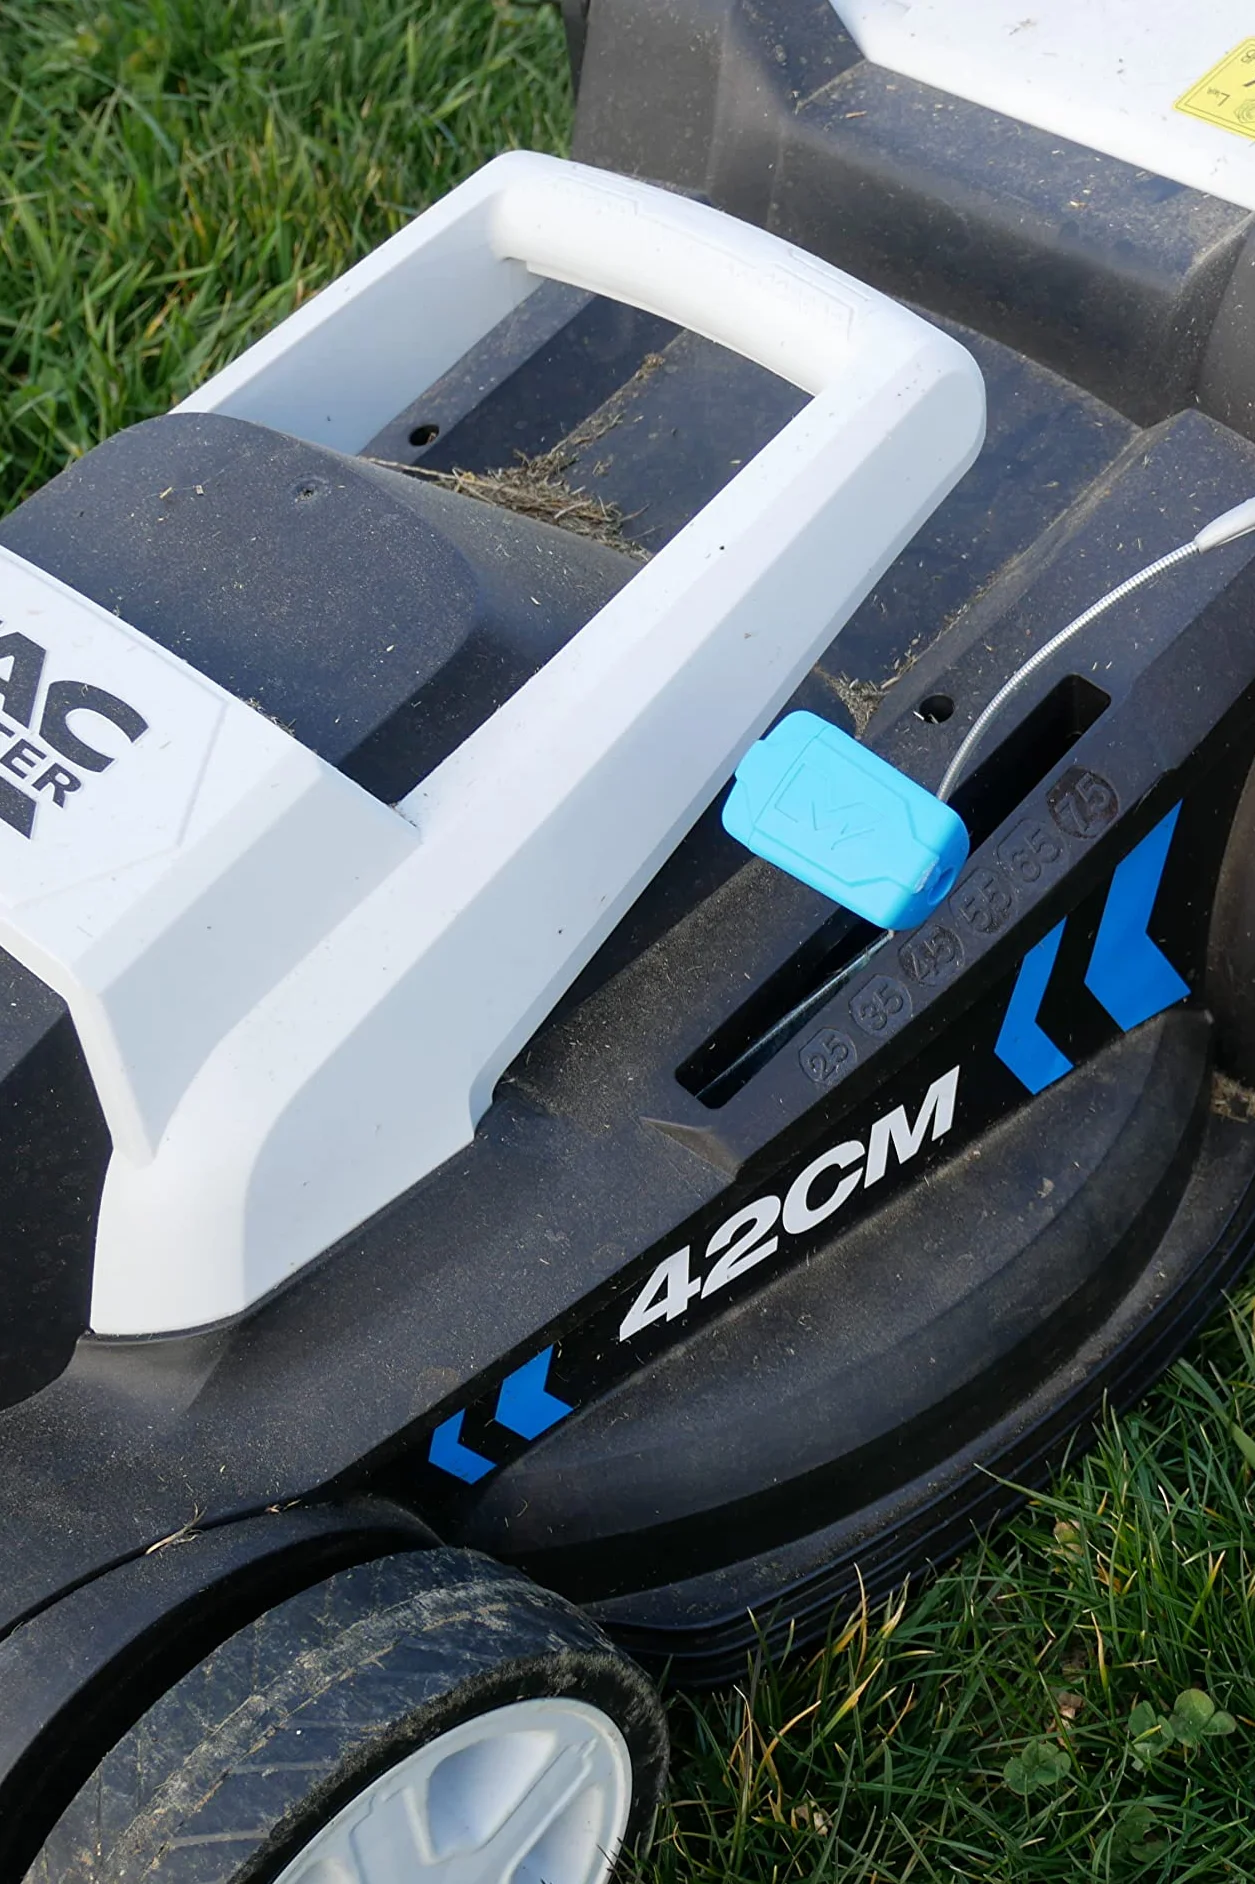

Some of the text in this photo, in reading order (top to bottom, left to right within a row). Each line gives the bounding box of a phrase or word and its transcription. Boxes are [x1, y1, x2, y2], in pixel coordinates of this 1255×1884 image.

[0, 621, 149, 773] AC
[808, 1031, 849, 1080] 25
[860, 982, 904, 1031] 35
[1055, 769, 1111, 833] 75
[619, 1065, 960, 1342] 42CM
